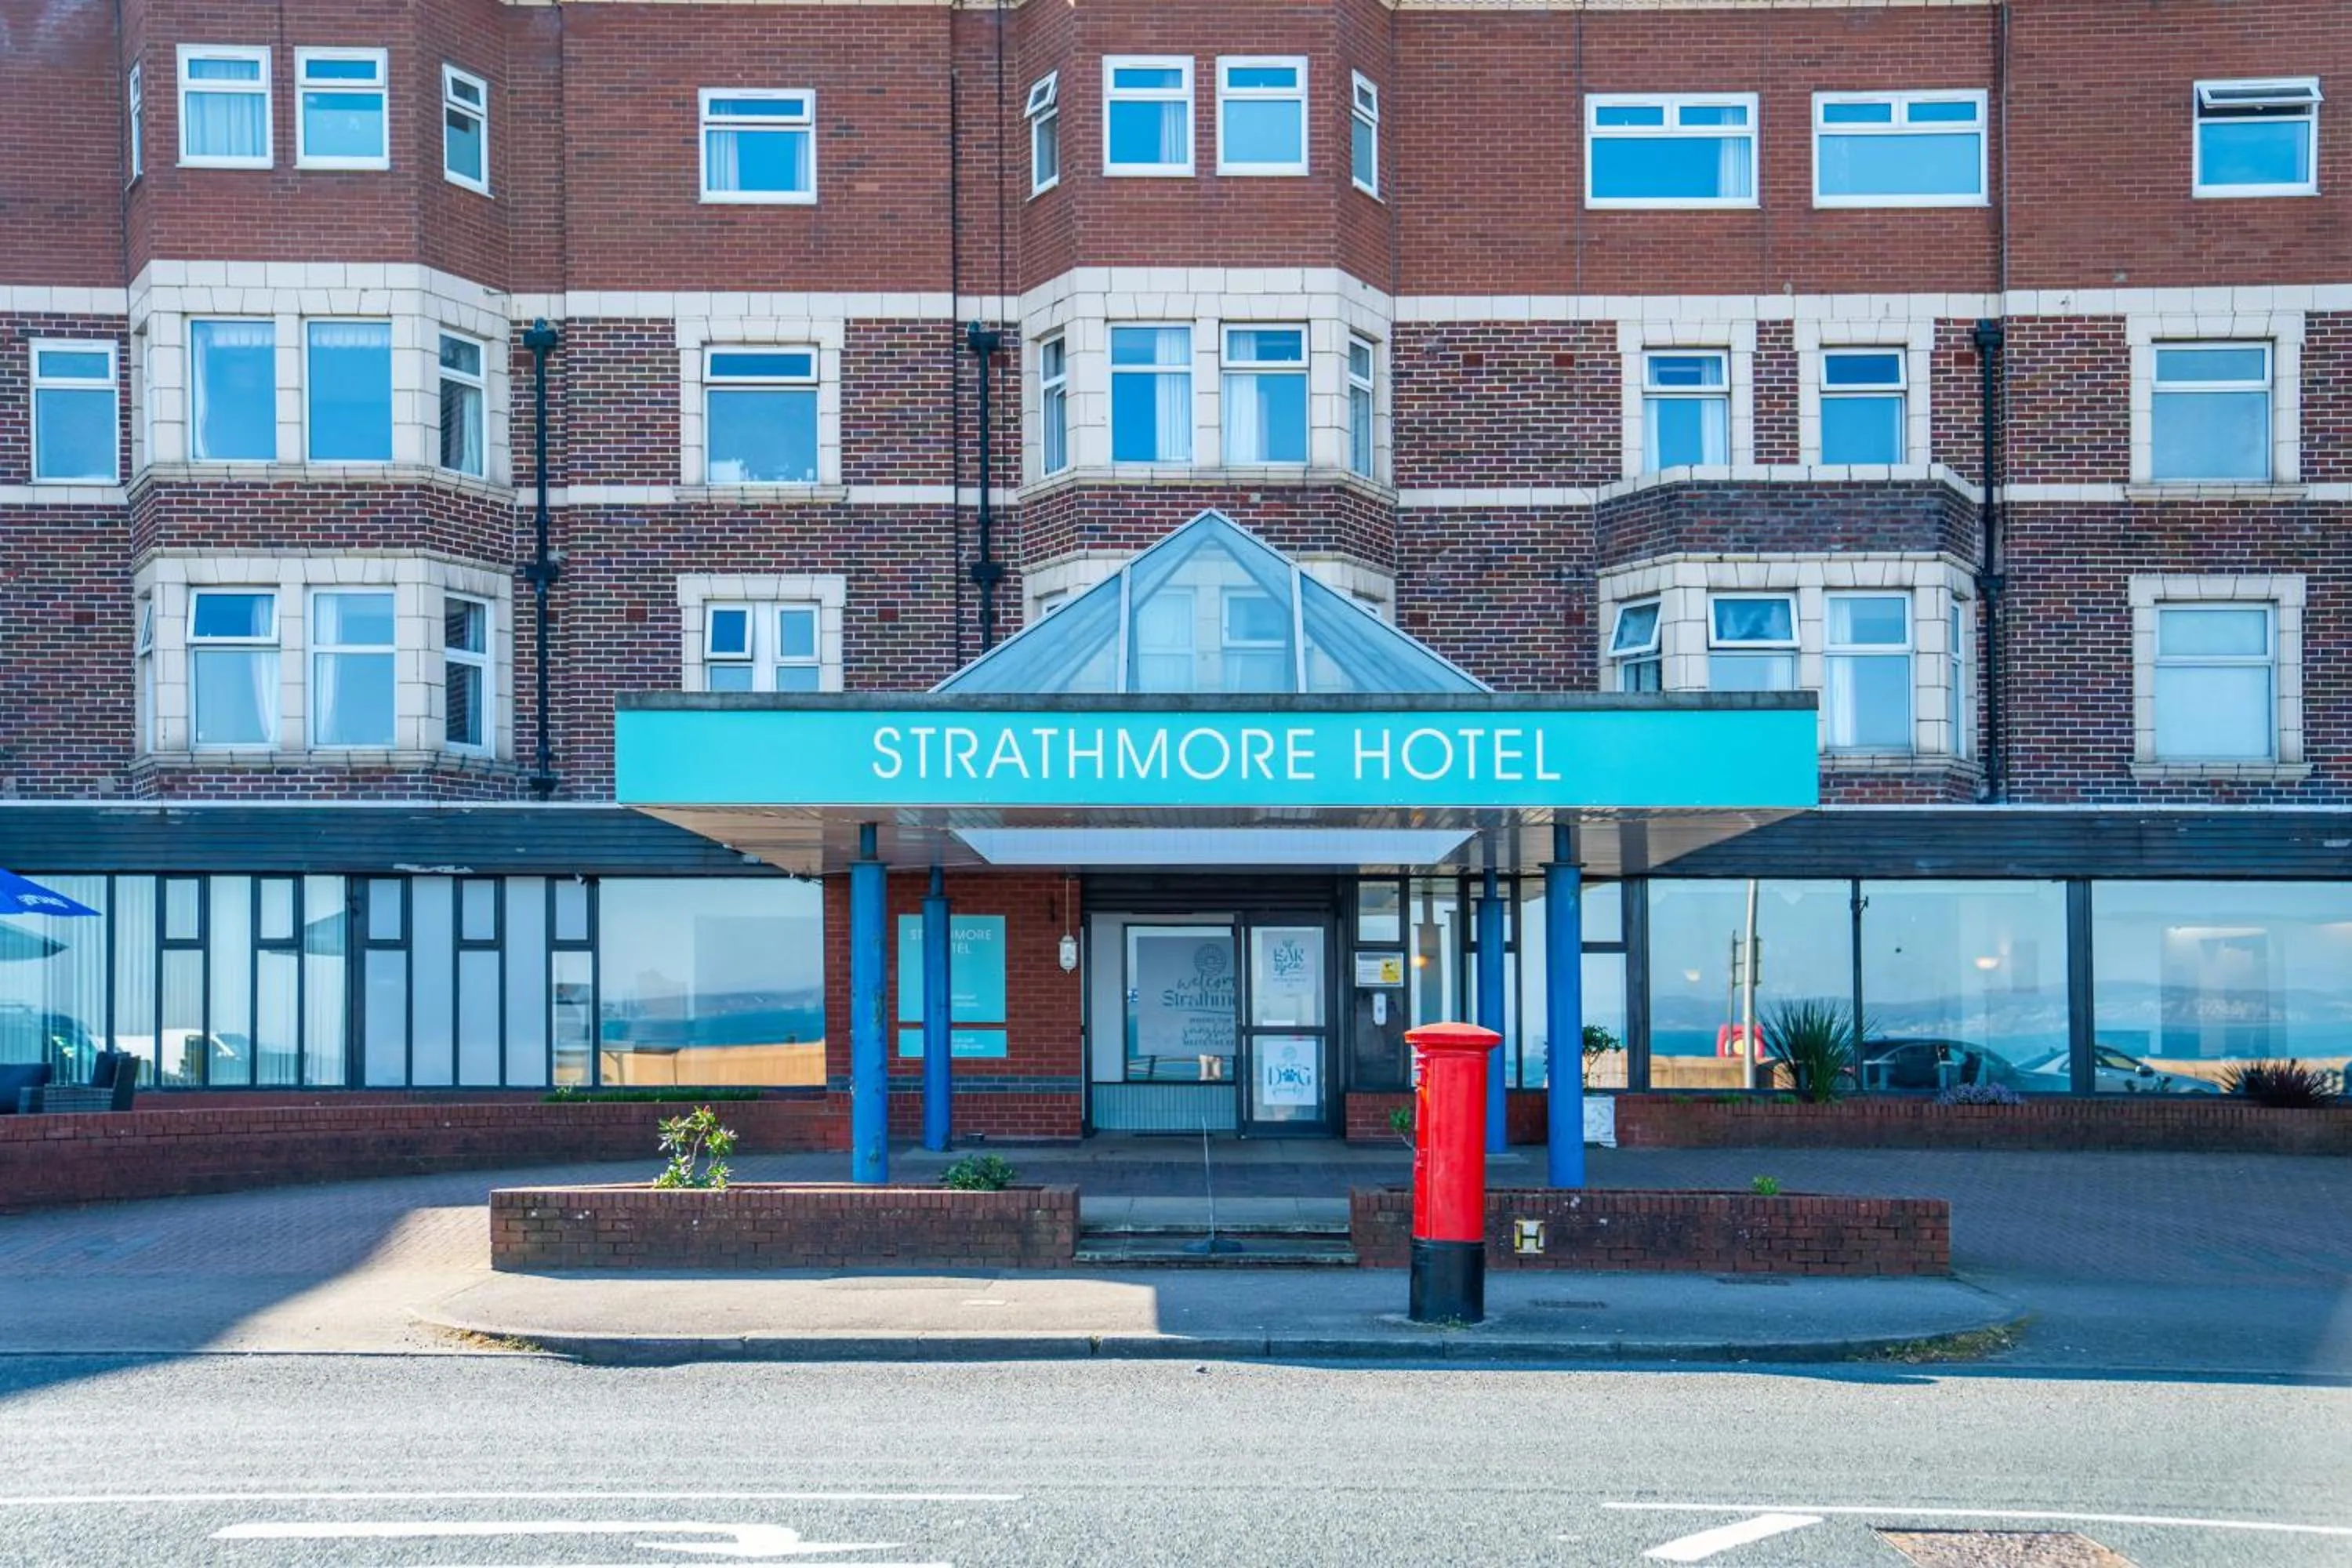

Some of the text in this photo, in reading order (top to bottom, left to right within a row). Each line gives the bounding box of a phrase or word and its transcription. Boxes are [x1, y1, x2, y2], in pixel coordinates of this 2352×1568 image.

[873, 727, 1562, 781] STRATHMORE HOTEL
[909, 929, 992, 941] STMORE
[1517, 1223, 1542, 1250] H
